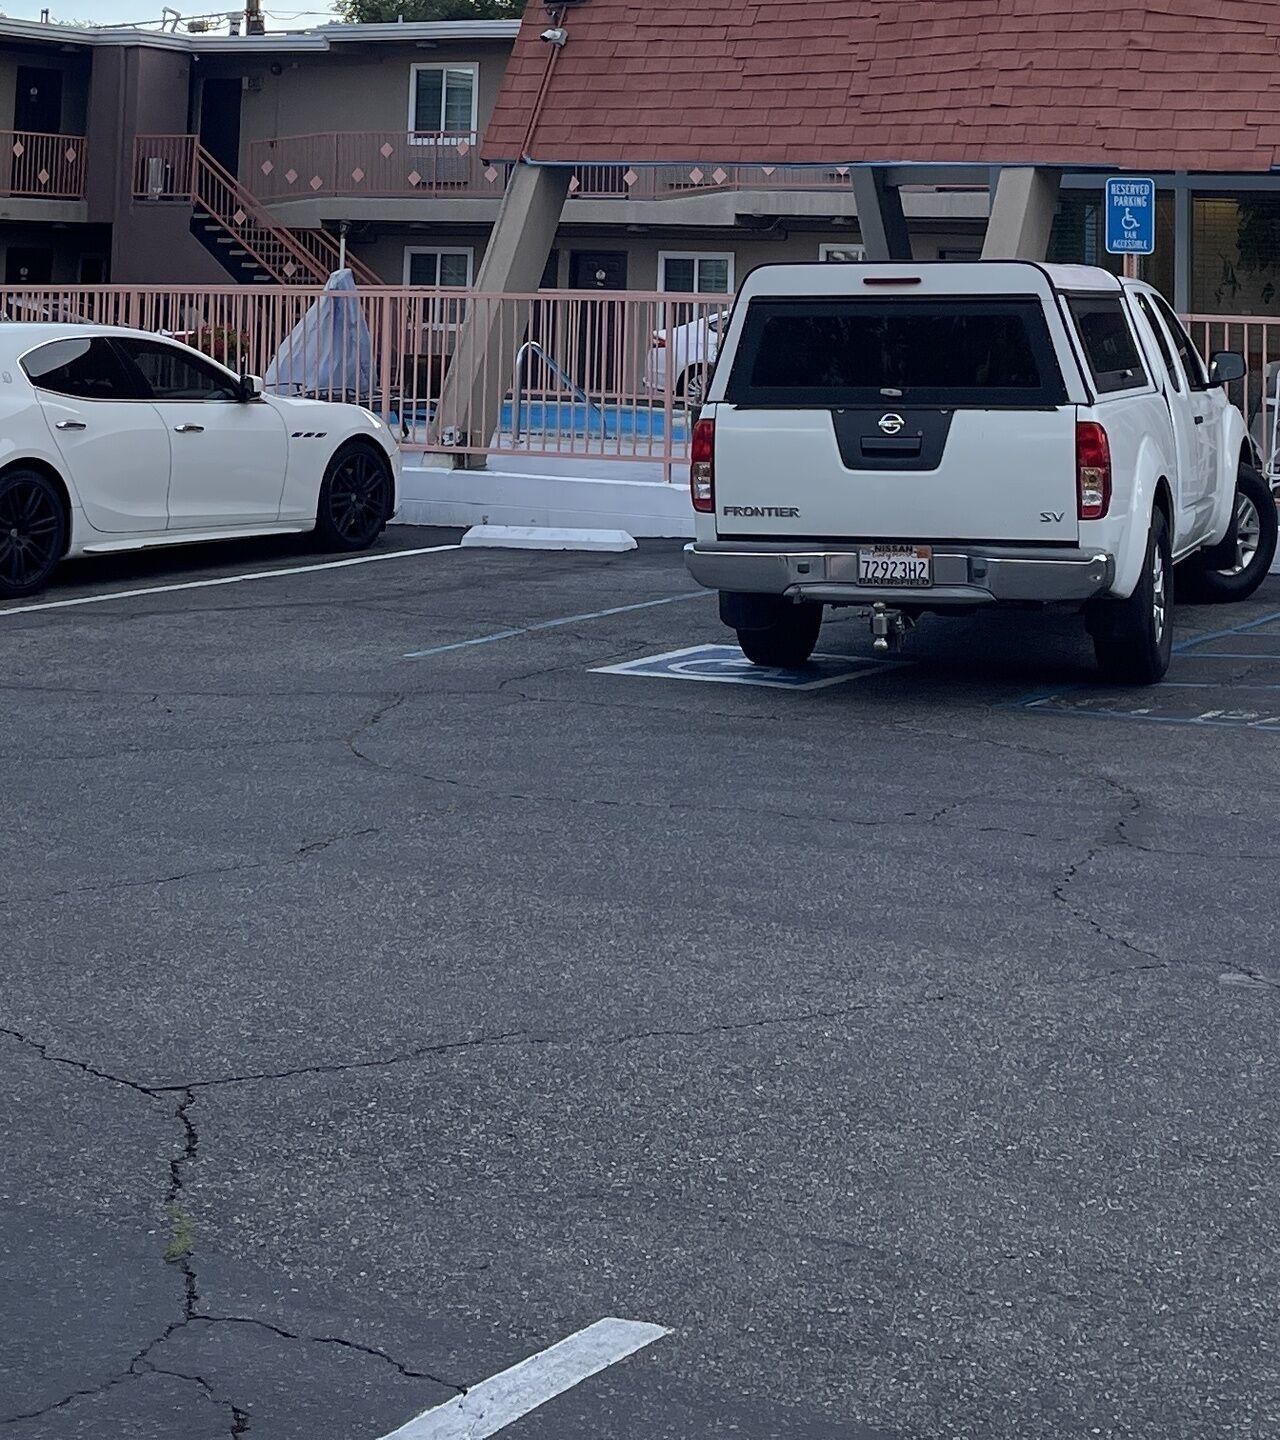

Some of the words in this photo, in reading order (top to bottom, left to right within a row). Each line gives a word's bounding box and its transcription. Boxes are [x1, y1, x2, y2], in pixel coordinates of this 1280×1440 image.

[1111, 183, 1150, 195] RESERVED
[1113, 195, 1147, 207] PARKING
[1124, 231, 1137, 239] VAN
[723, 506, 801, 518] FRONTIER
[1040, 511, 1065, 523] SV
[862, 560, 927, 579] 72923H2
